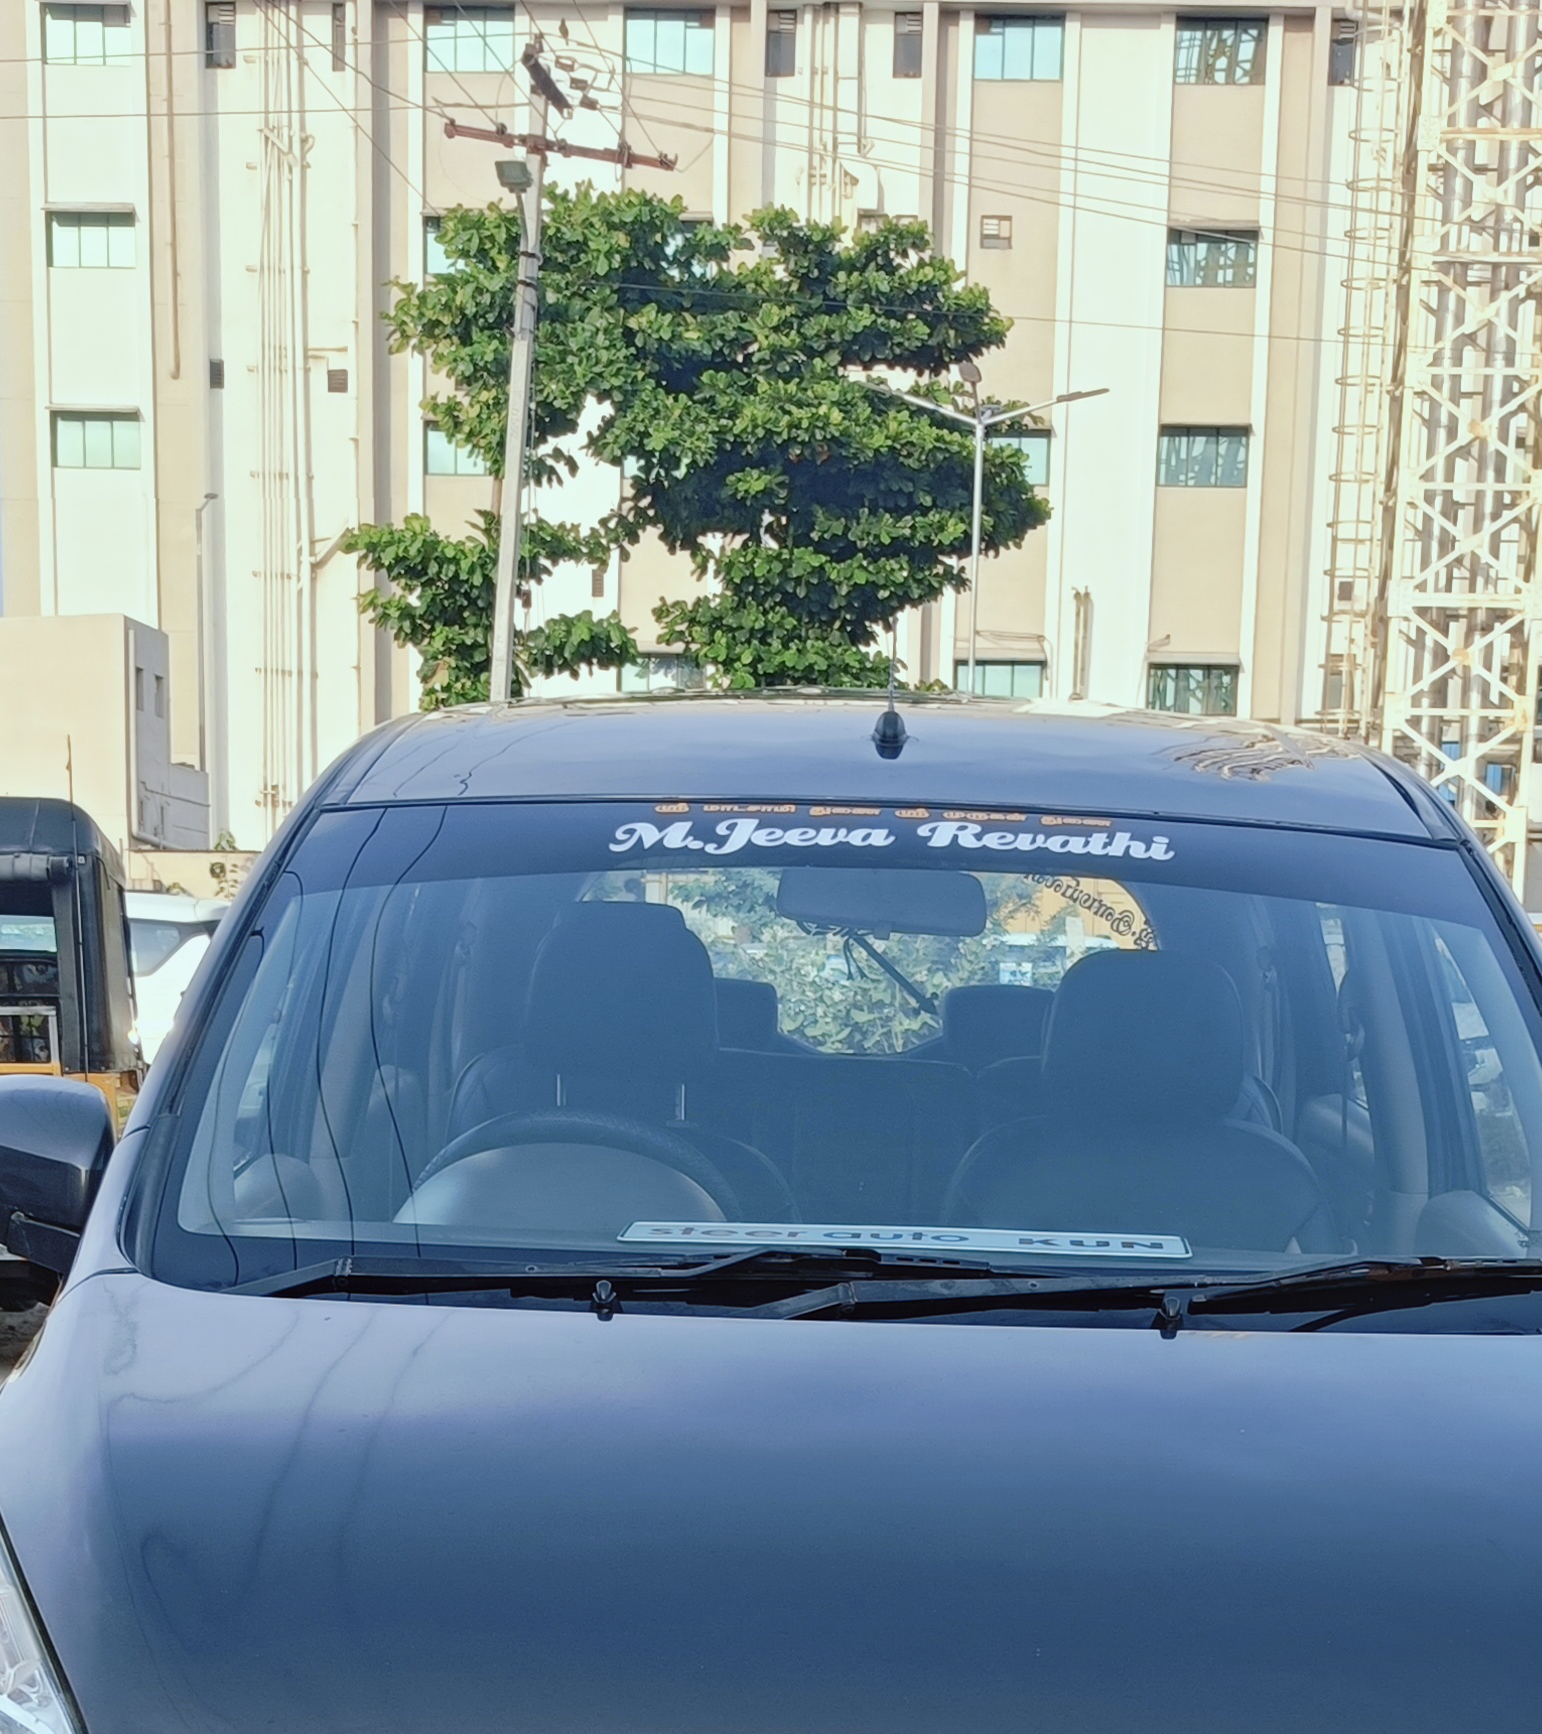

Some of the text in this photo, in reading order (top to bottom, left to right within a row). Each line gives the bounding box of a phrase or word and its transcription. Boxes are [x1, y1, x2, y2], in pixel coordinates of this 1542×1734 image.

[808, 806, 882, 817] துணை
[1040, 814, 1112, 827] துணை
[609, 818, 1176, 861] M.Jeeva Revathi
[647, 1226, 1165, 1250] steer auto KUN
